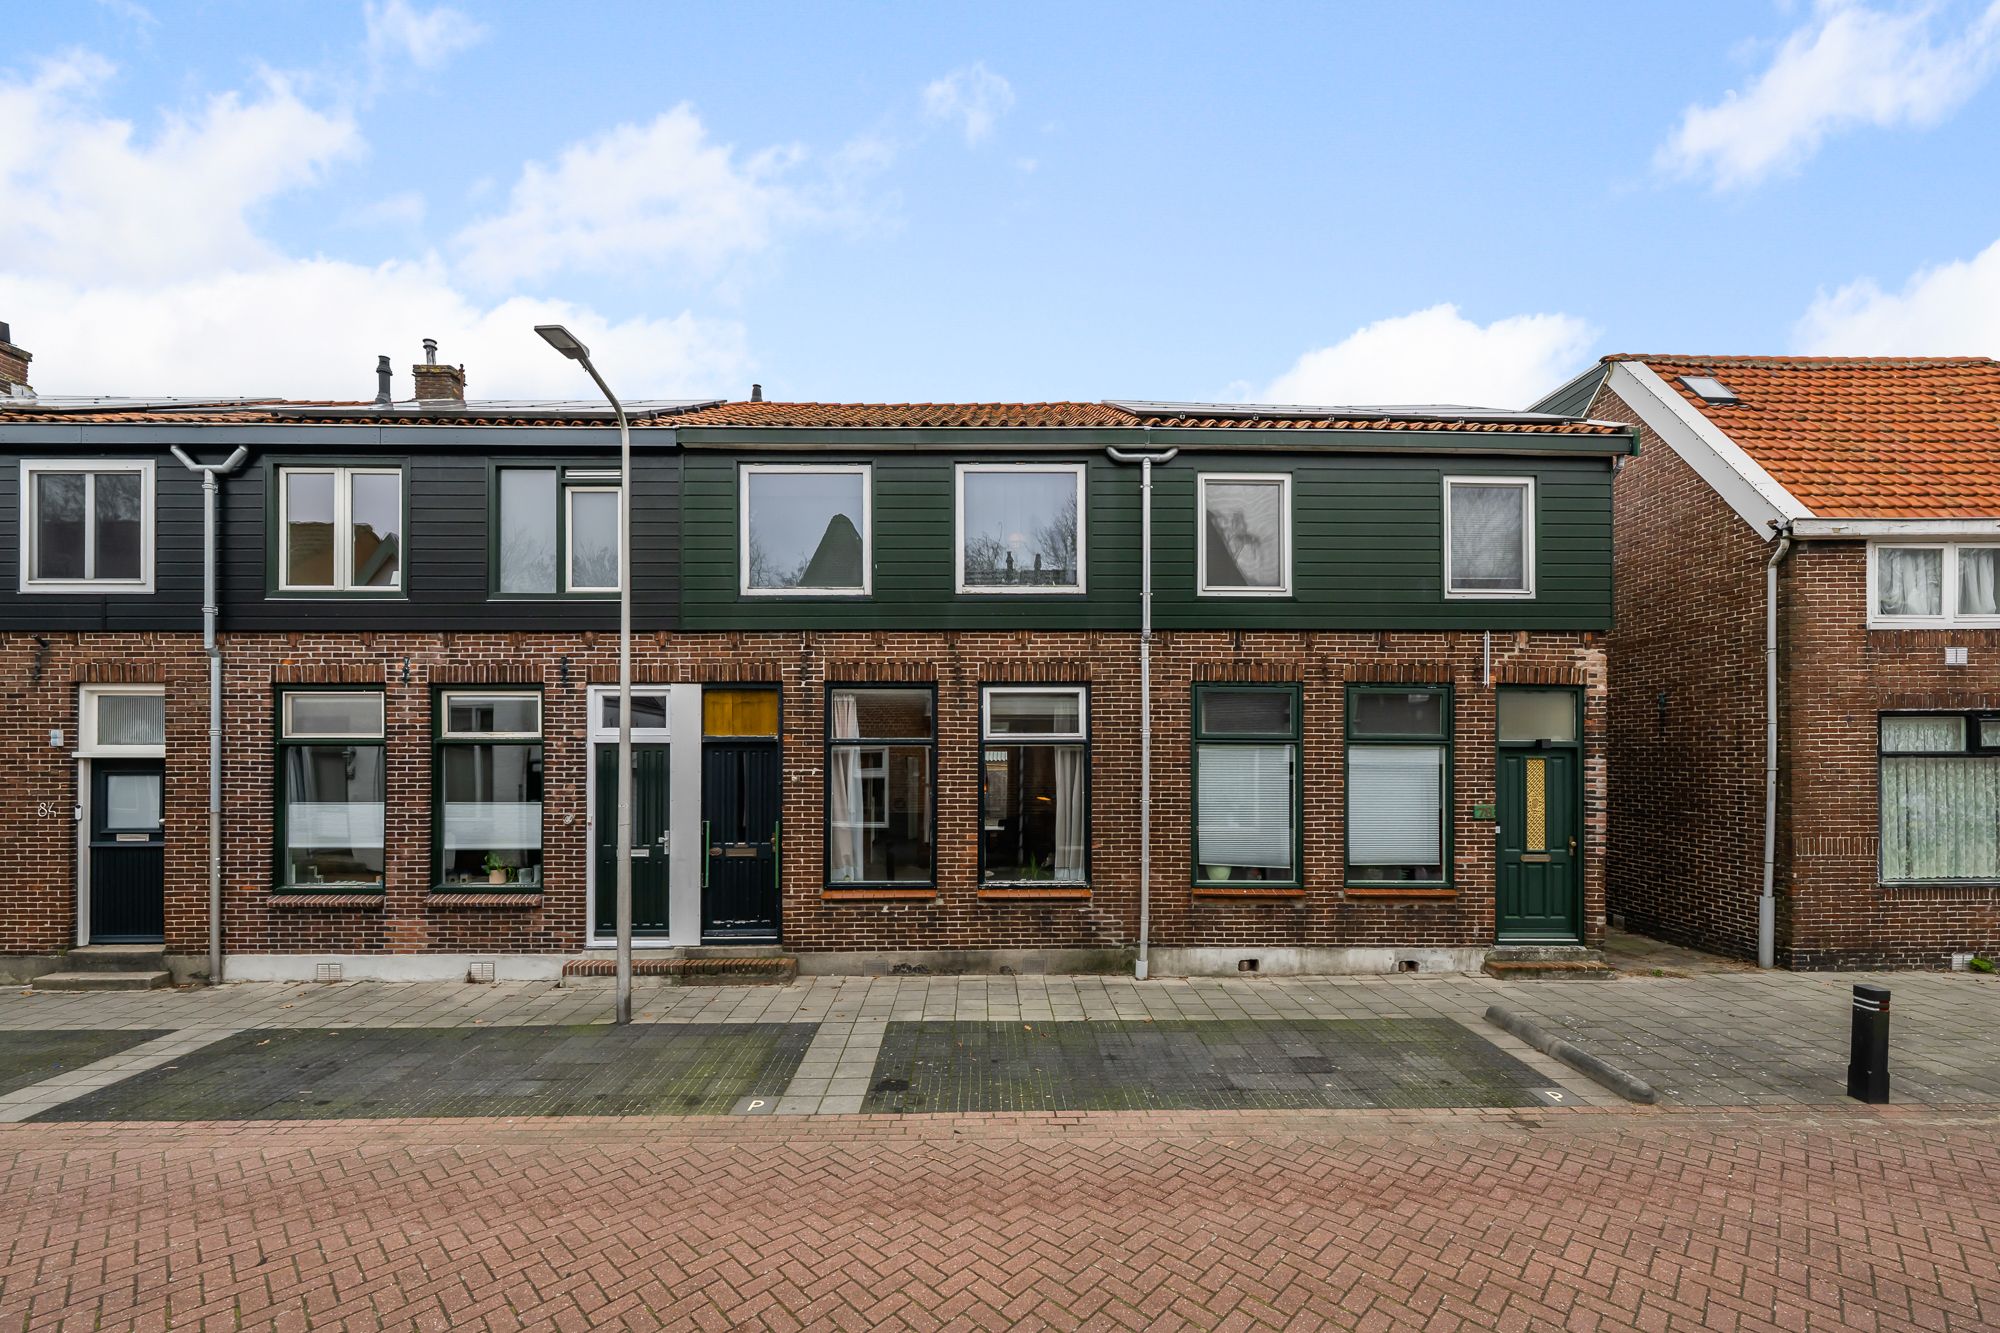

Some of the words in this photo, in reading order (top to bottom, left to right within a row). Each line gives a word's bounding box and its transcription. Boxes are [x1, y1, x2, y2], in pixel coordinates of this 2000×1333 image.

[38, 802, 56, 817] 84
[1545, 1091, 1563, 1102] P
[747, 1100, 765, 1111] P
